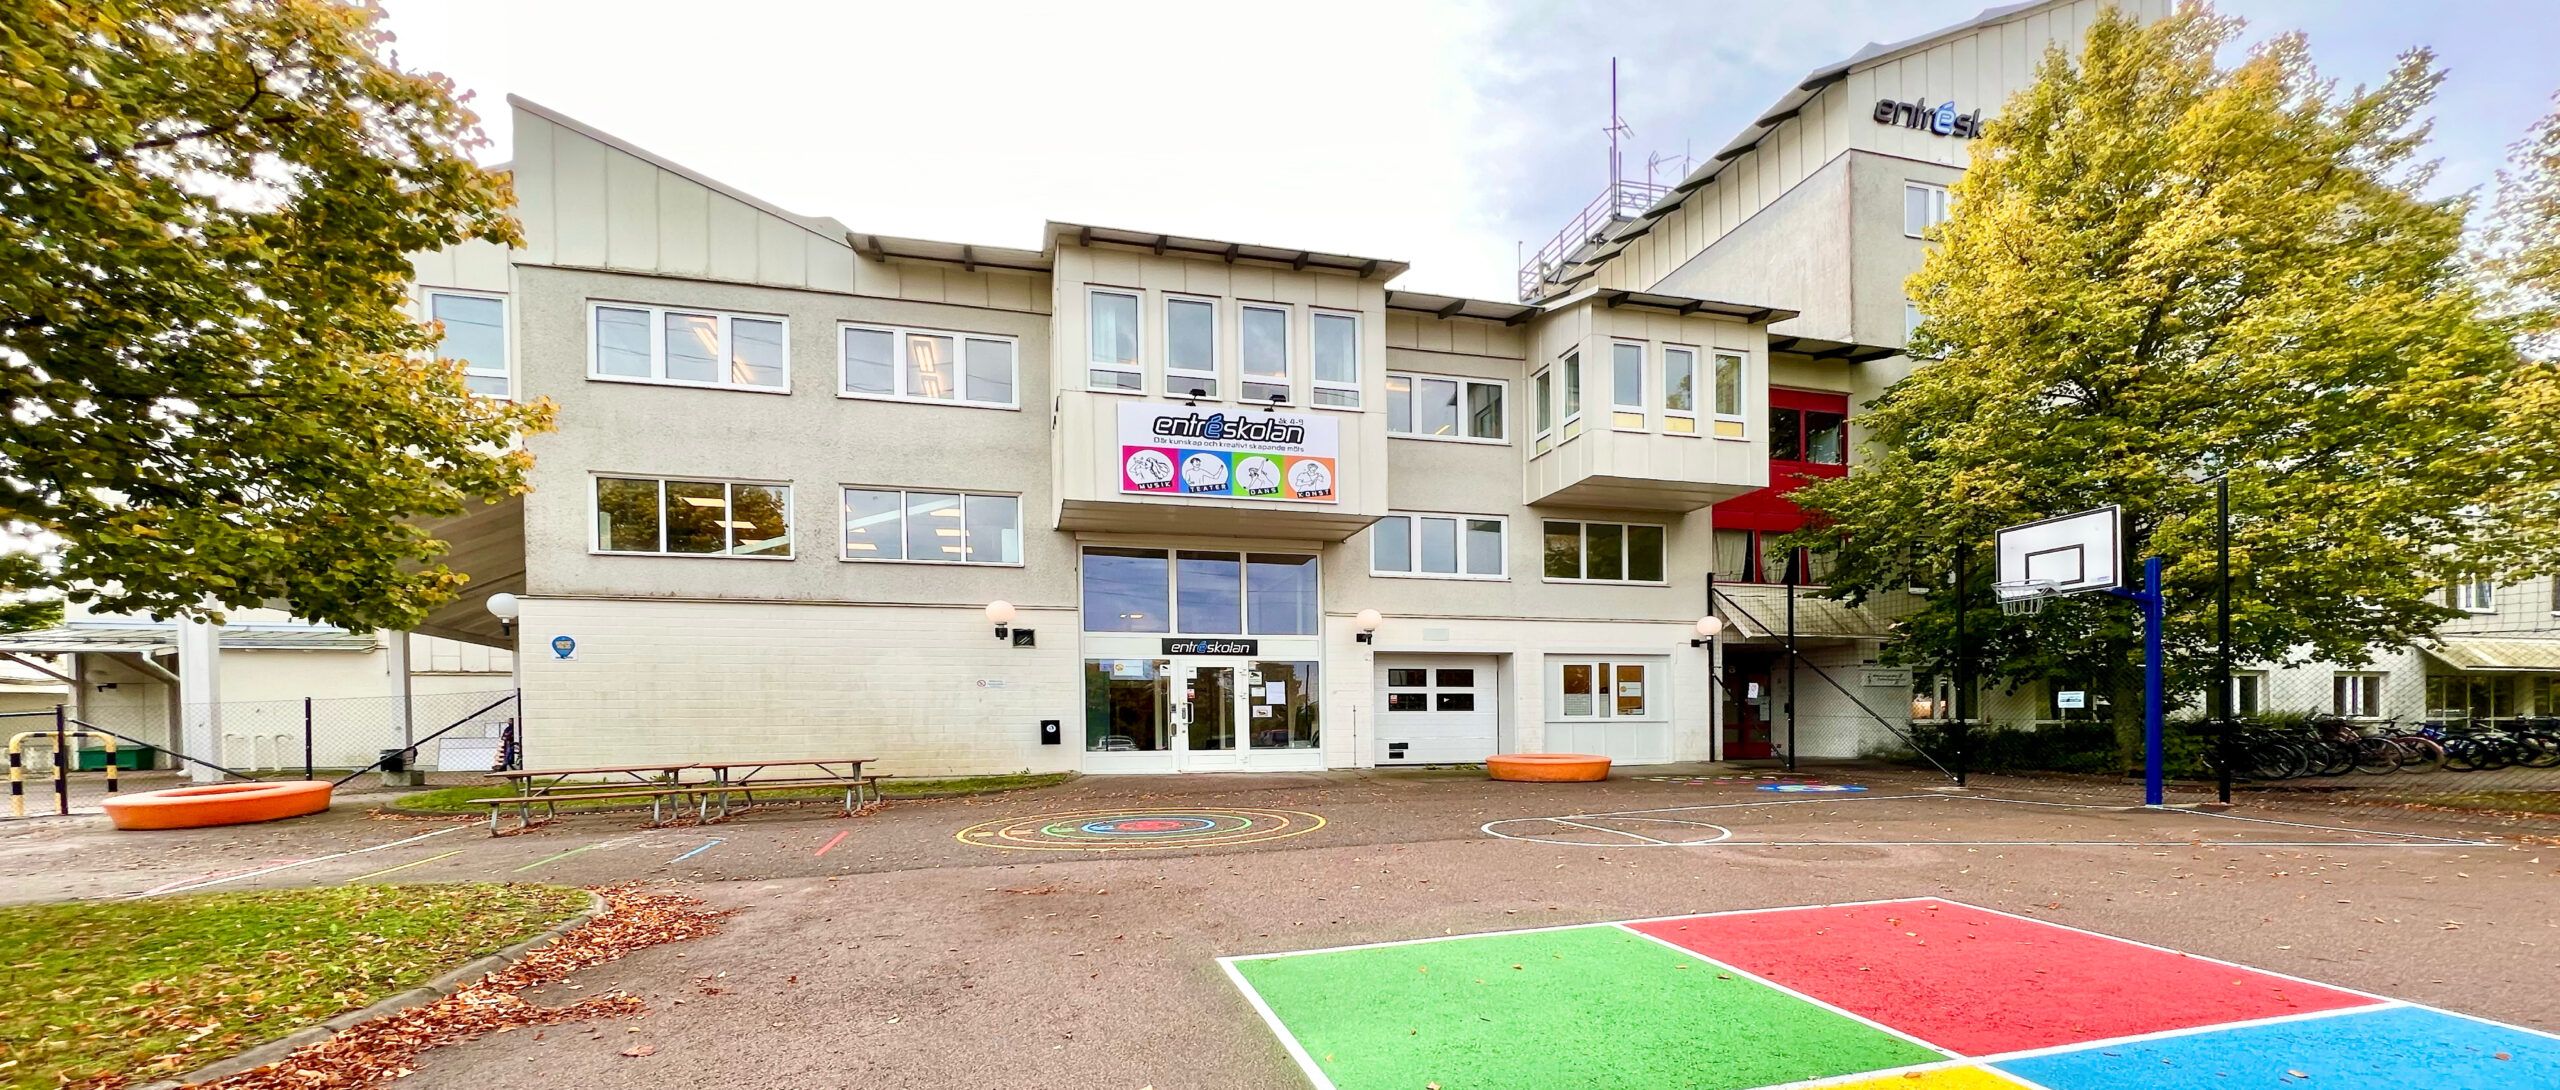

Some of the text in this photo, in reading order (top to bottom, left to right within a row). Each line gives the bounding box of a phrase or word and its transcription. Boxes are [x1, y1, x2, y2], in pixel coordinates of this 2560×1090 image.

[1153, 413, 1304, 444] entréskolan
[1153, 436, 1304, 453] Där kunskap och kreativt skapande möts
[1138, 481, 1171, 490] MUSIK
[1190, 483, 1227, 492] TEATER
[1250, 487, 1277, 495] DANS
[1297, 489, 1330, 498] KONST
[1170, 640, 1250, 654] entréskolan
